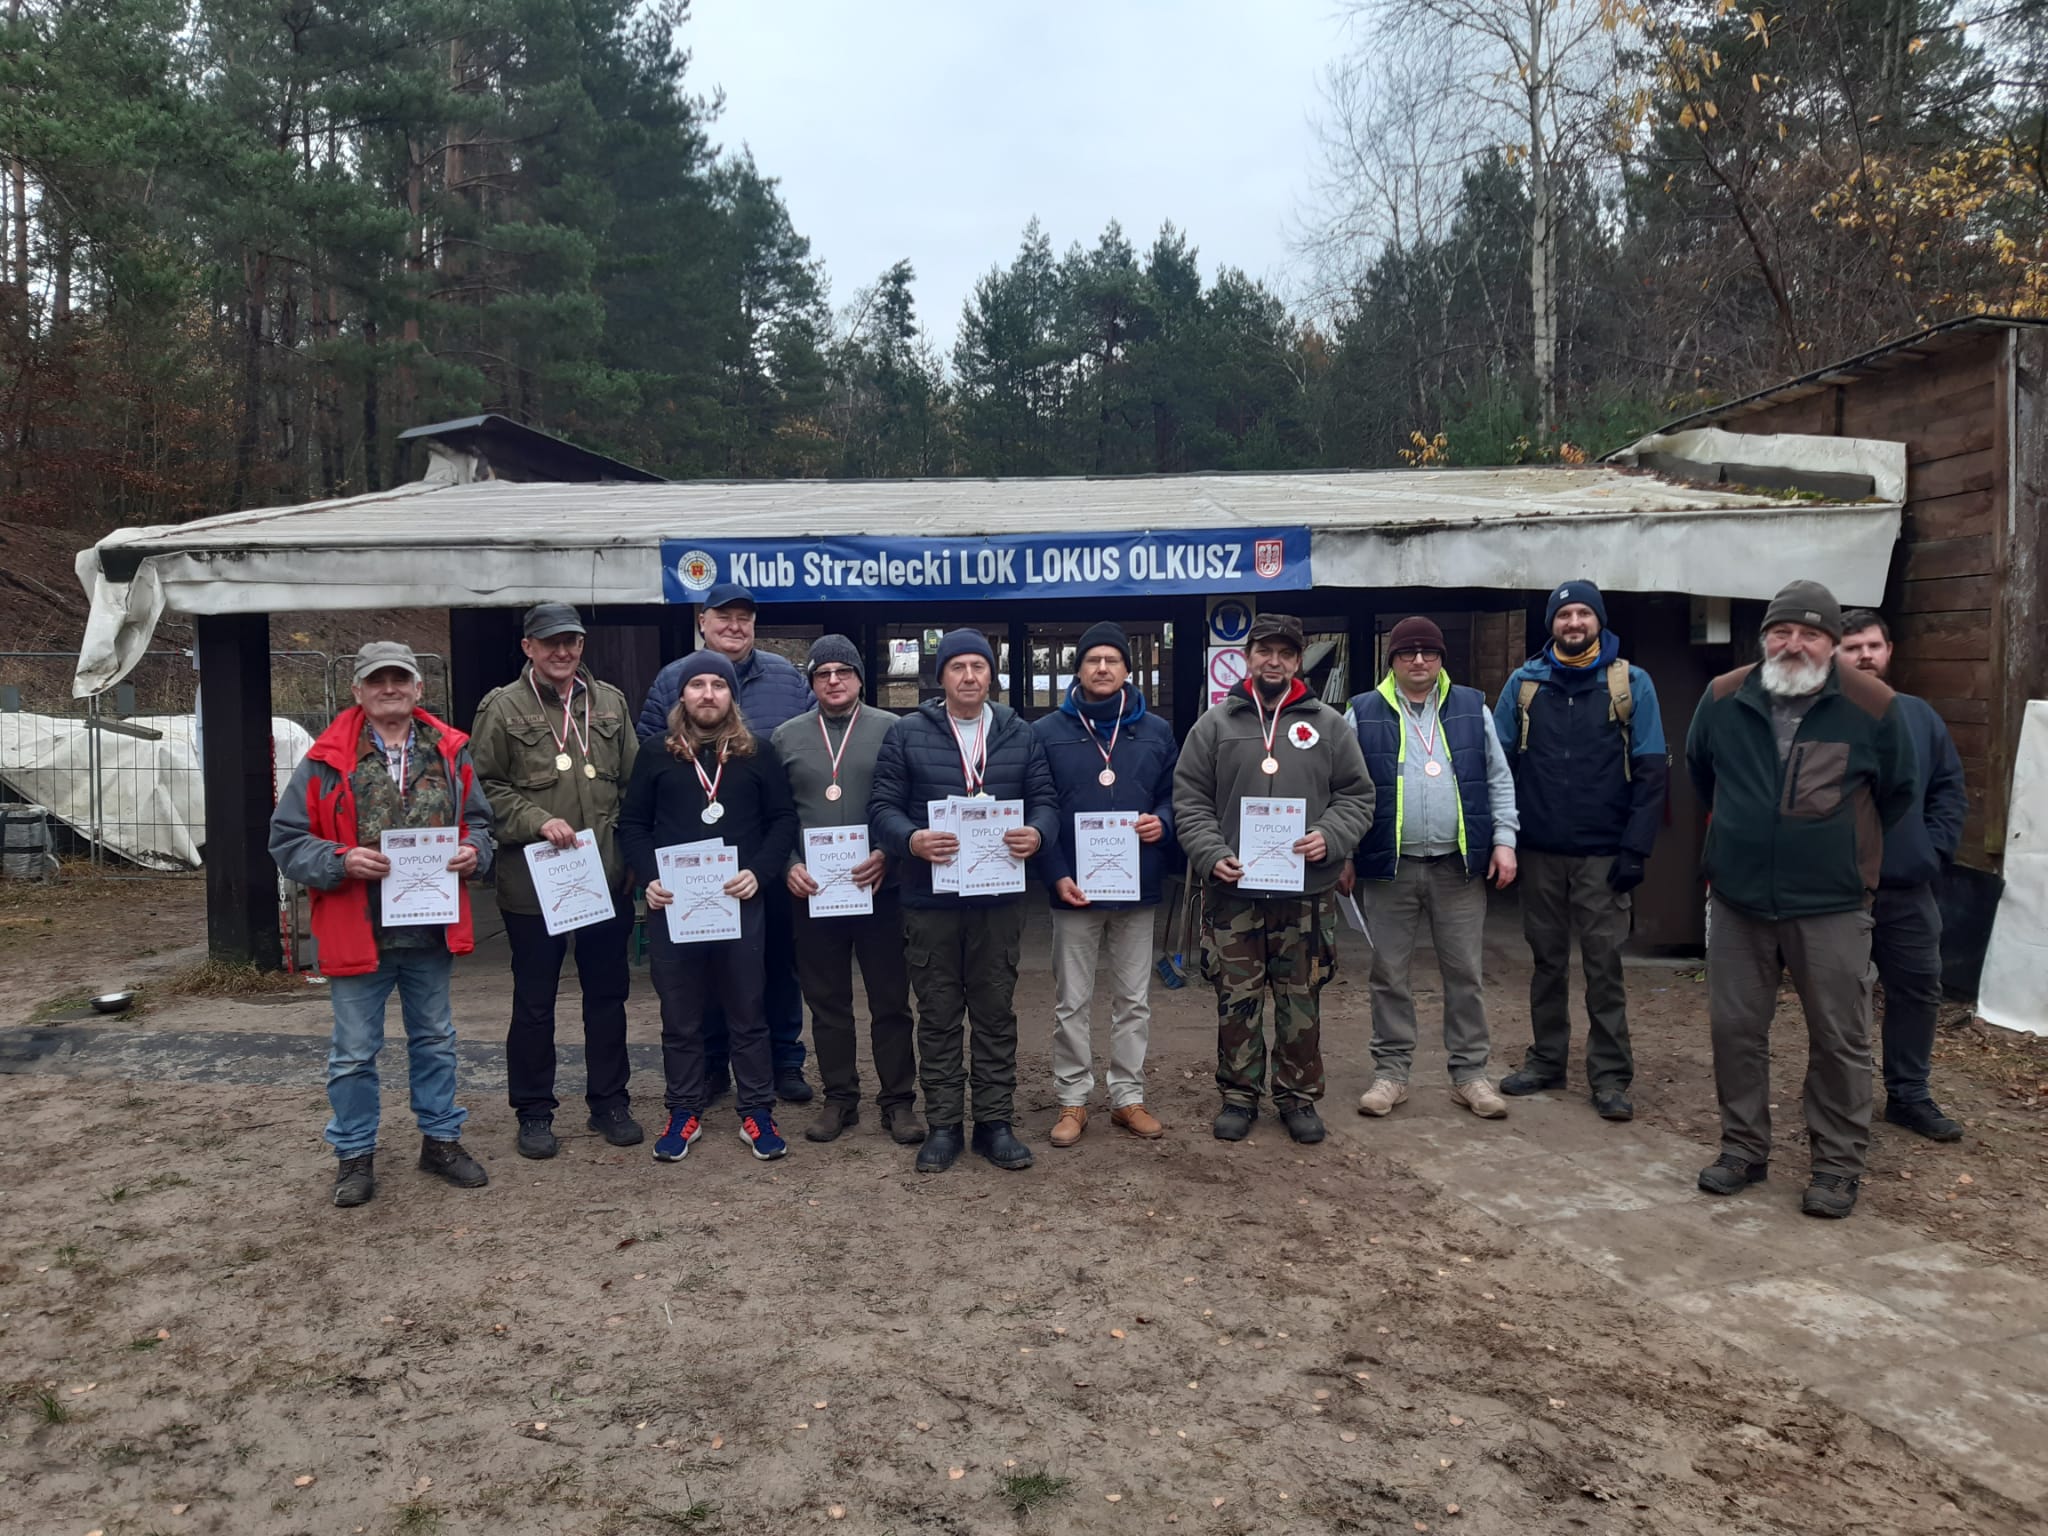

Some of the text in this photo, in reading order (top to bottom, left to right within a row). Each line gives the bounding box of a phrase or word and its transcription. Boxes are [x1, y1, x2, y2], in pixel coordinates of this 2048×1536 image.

[729, 551, 796, 588] Klub
[802, 549, 952, 587] Strzelecki
[960, 548, 1017, 585] LOK
[1025, 546, 1121, 583] LOKUS
[1128, 543, 1243, 581] OLKUSZ
[1254, 823, 1293, 834] DYPLOM
[1089, 836, 1127, 847] DYPLOM
[398, 854, 443, 866] DYPLOM
[819, 851, 857, 862] DYPLOM
[547, 858, 588, 877] DYPLOM
[685, 873, 725, 884] DYPLOM
